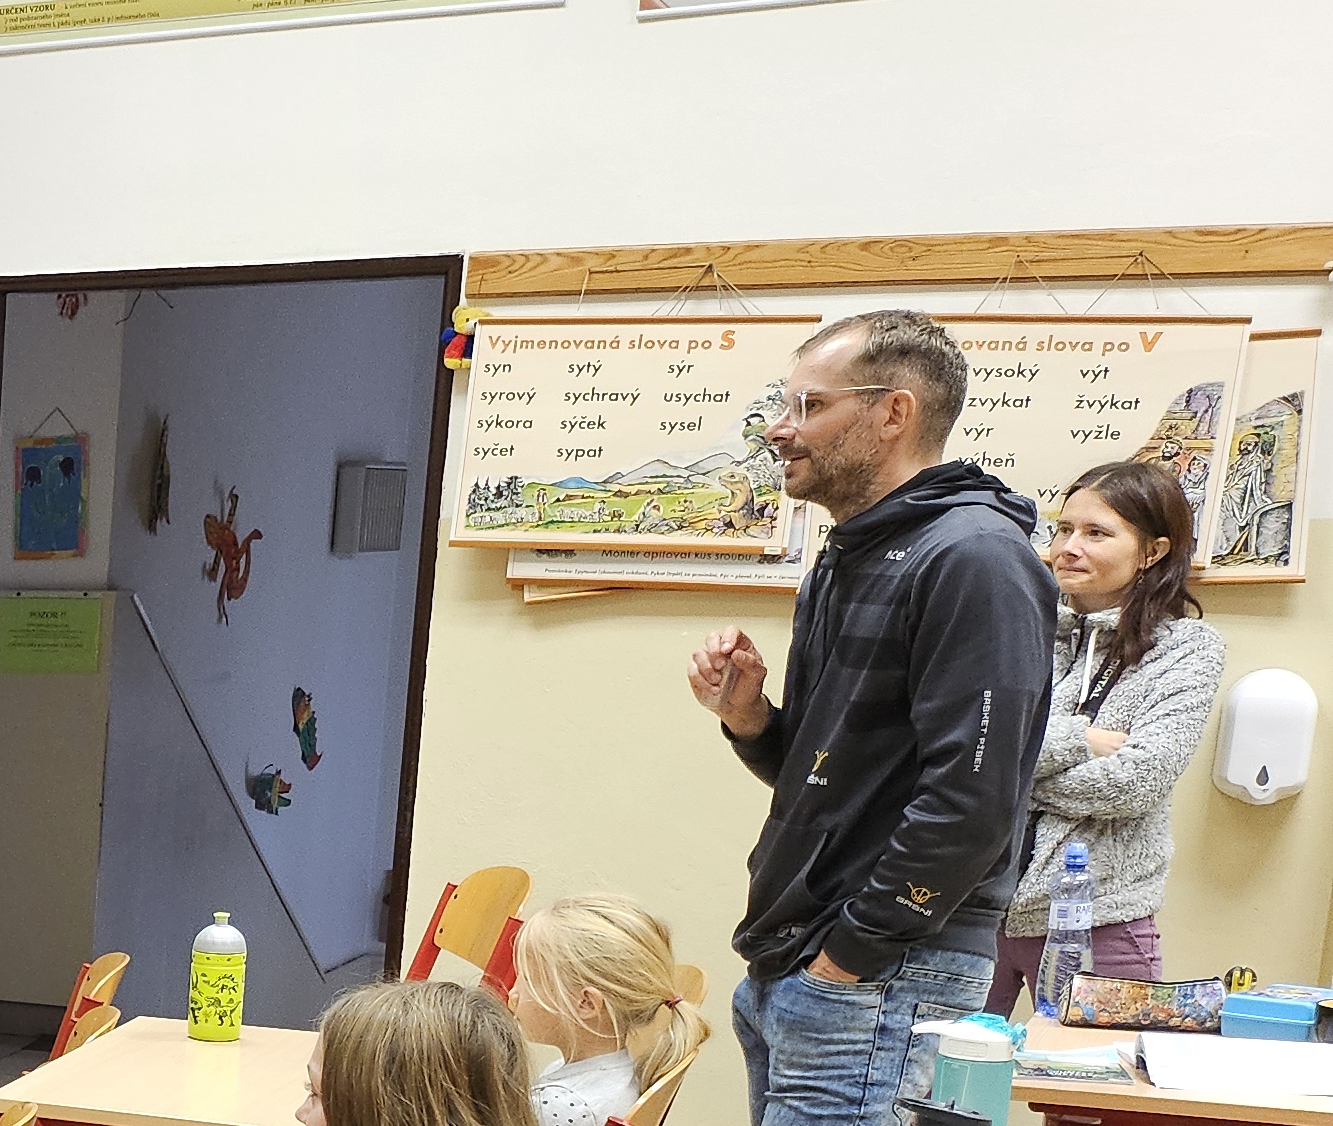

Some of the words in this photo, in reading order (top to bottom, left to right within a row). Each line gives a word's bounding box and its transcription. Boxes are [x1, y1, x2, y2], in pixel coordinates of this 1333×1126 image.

[0, 5, 28, 16] URČENÍ
[29, 4, 56, 13] VZORU
[488, 334, 620, 353] Vyjmenovaná
[627, 333, 680, 351] slova
[687, 338, 713, 354] po
[719, 329, 736, 351] S
[1035, 335, 1094, 352] slova
[1101, 340, 1131, 357] po
[1139, 331, 1163, 353] V
[483, 361, 512, 377] syn
[567, 359, 603, 378] sytý
[667, 359, 695, 378] sýr
[972, 362, 1041, 382] vysoký
[1079, 364, 1110, 383] výt
[480, 387, 537, 406] syrový
[563, 387, 641, 406] sychravý
[663, 388, 731, 407] usychat
[967, 392, 1032, 412] zvykat
[1073, 394, 1141, 414] žvýkat
[476, 414, 533, 433] sýkora
[559, 415, 608, 434] sýček
[659, 416, 703, 435] sysel
[963, 423, 995, 441] výr
[1070, 424, 1121, 444] vyžle
[473, 443, 515, 461] syčet
[556, 445, 604, 462] sypat
[958, 451, 1016, 468] výheň
[1088, 658, 1121, 701] DIGITAL
[979, 690, 992, 734] BASKET
